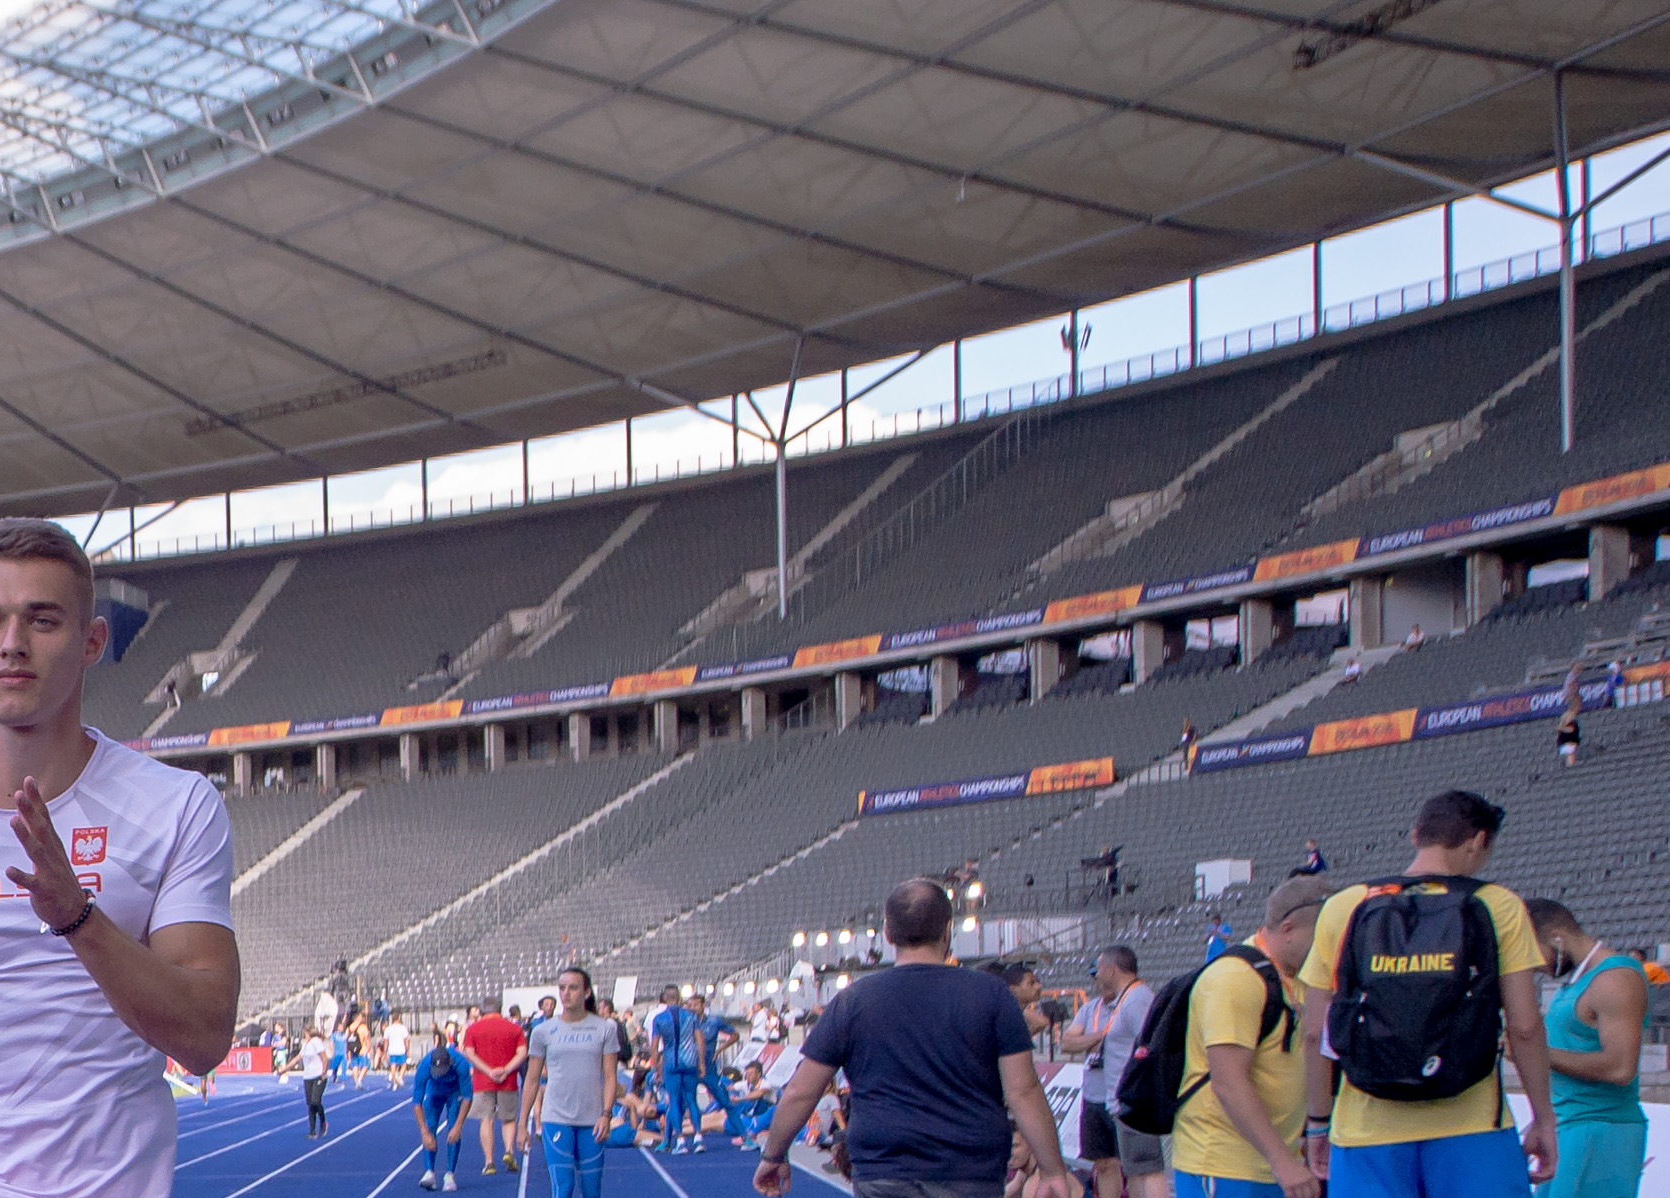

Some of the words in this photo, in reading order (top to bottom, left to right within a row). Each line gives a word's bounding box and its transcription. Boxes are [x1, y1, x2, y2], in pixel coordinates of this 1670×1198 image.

[874, 789, 920, 810] EUROPEAN
[1370, 952, 1456, 974] UKRAINE
[558, 1033, 592, 1045] ITALIA
